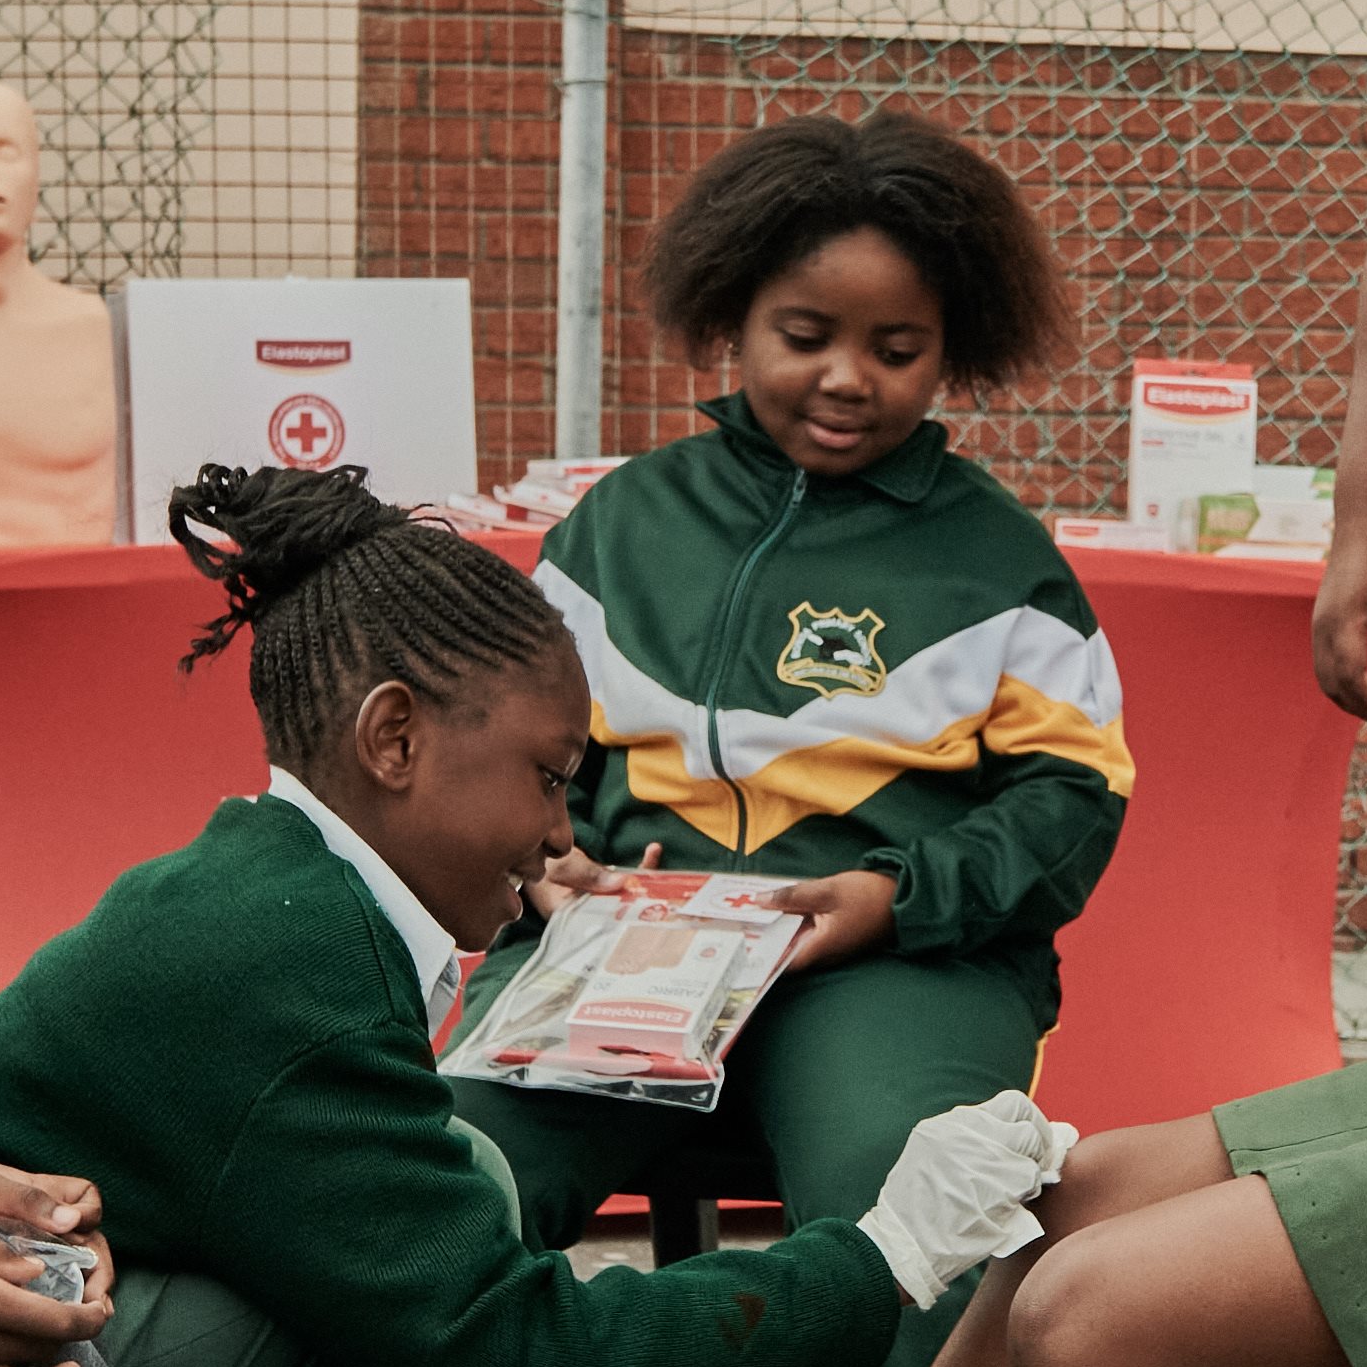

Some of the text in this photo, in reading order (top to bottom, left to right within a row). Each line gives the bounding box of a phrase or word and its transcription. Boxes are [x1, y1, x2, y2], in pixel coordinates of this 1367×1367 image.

[261, 345, 347, 363] Elastoplast
[1147, 385, 1246, 411] Elastoplast
[584, 1005, 684, 1024] Elastoplast
